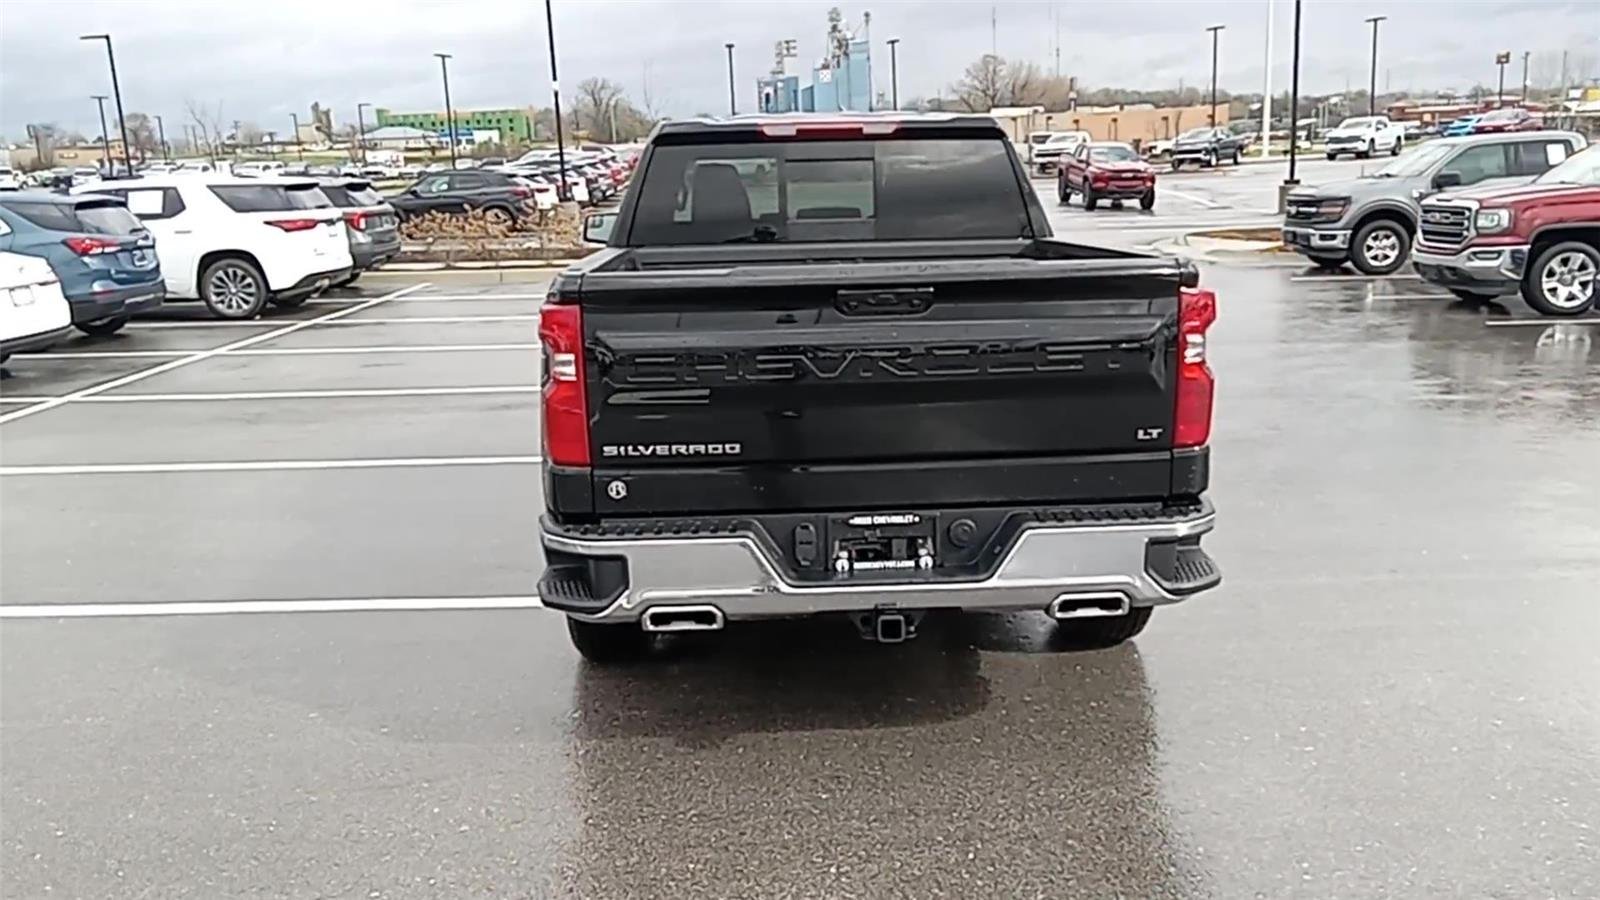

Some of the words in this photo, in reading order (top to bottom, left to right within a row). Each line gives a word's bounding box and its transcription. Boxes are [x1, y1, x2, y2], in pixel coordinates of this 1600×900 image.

[622, 343, 1138, 383] CHEVROLET
[1137, 428, 1163, 440] LT
[602, 443, 741, 457] SILVERADO
